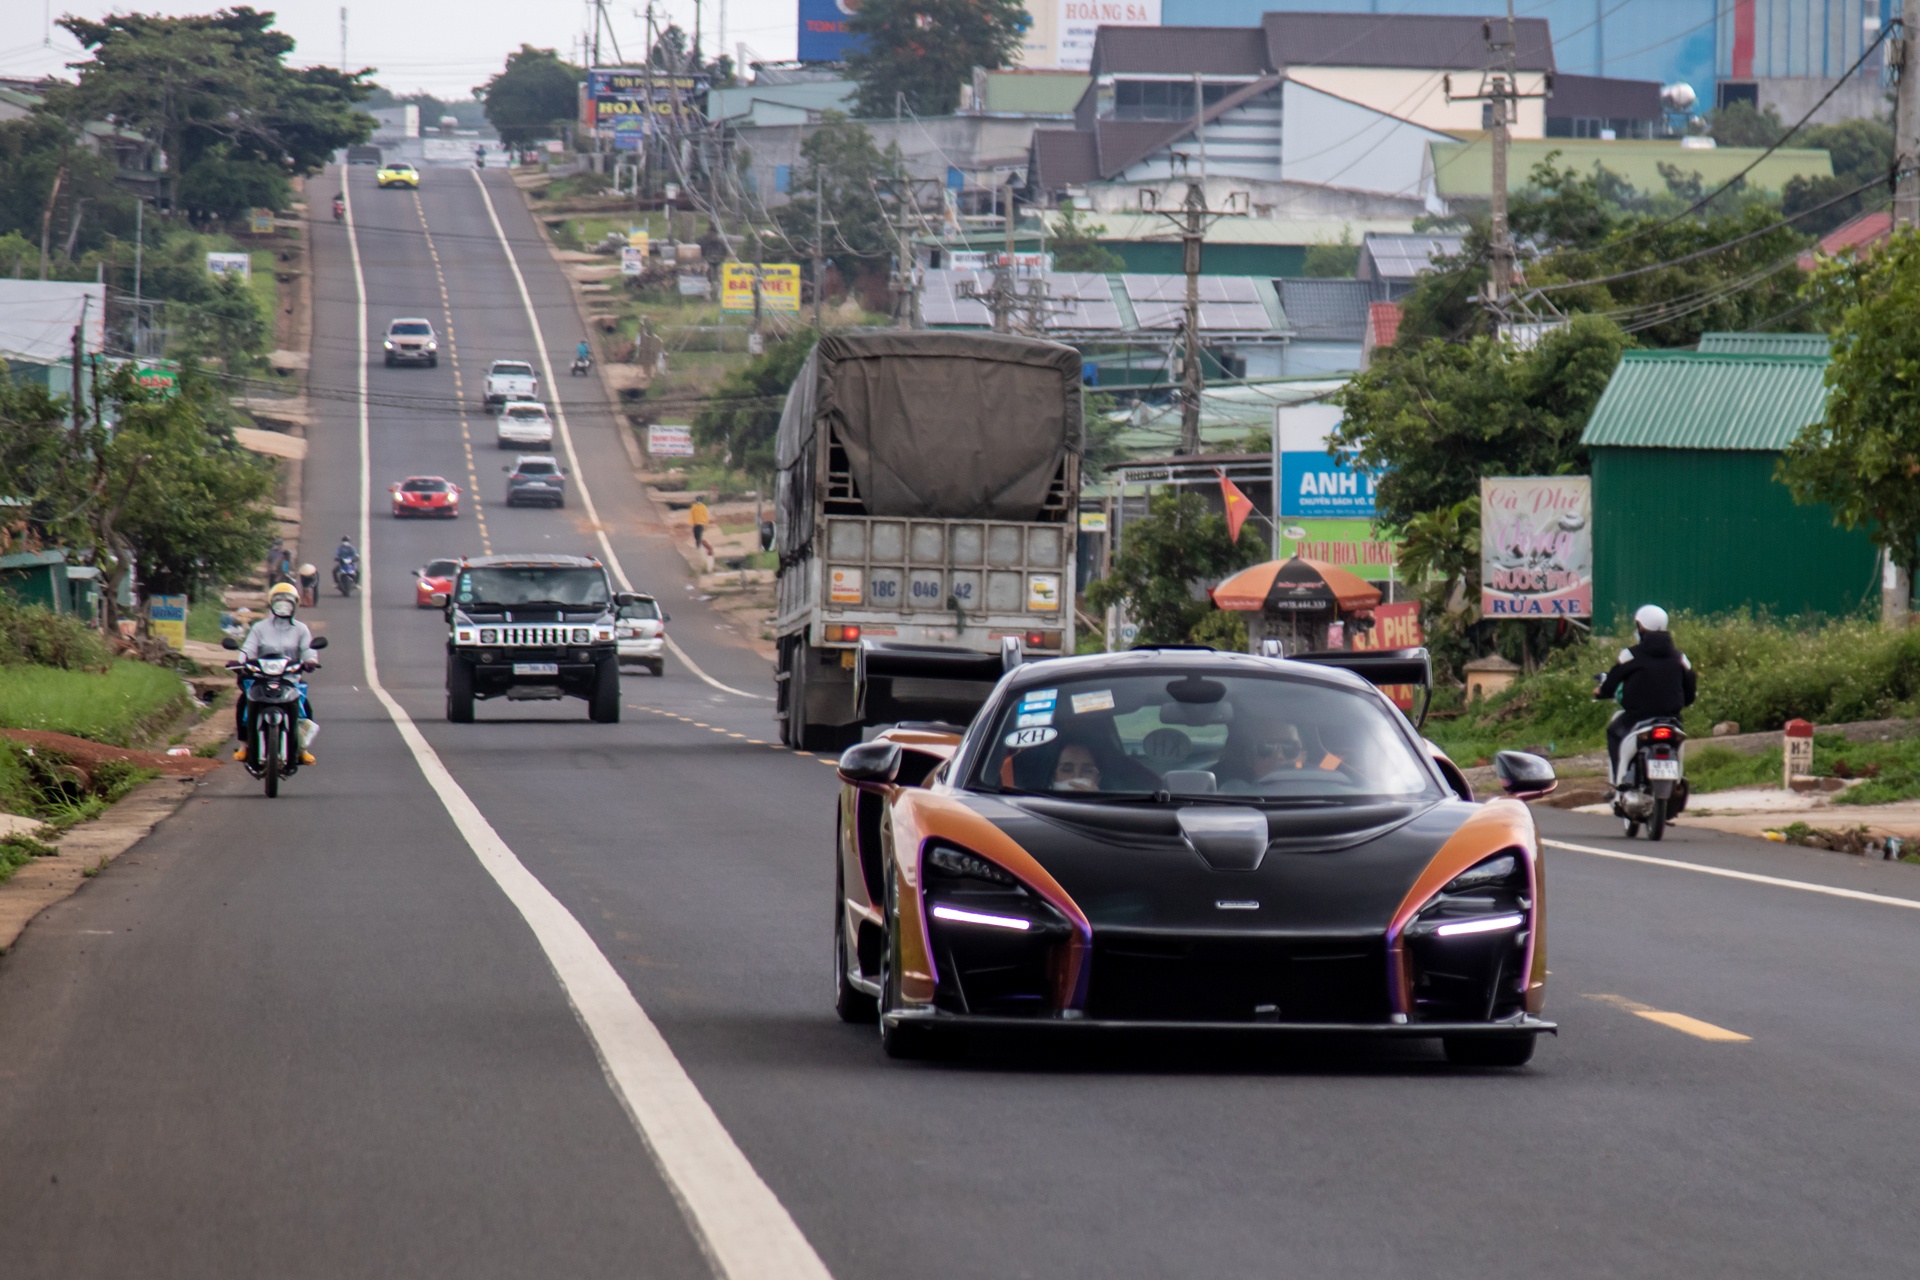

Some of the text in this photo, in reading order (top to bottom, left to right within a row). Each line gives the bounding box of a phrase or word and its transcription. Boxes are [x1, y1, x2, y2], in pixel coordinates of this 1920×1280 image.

[1126, 4, 1148, 20] SA
[1300, 472, 1357, 495] ANH
[871, 580, 896, 597] 18C
[954, 582, 972, 599] 42
[1493, 592, 1581, 613] RỬA XE
[1384, 607, 1421, 648] PHÊ
[1016, 729, 1046, 745] KH
